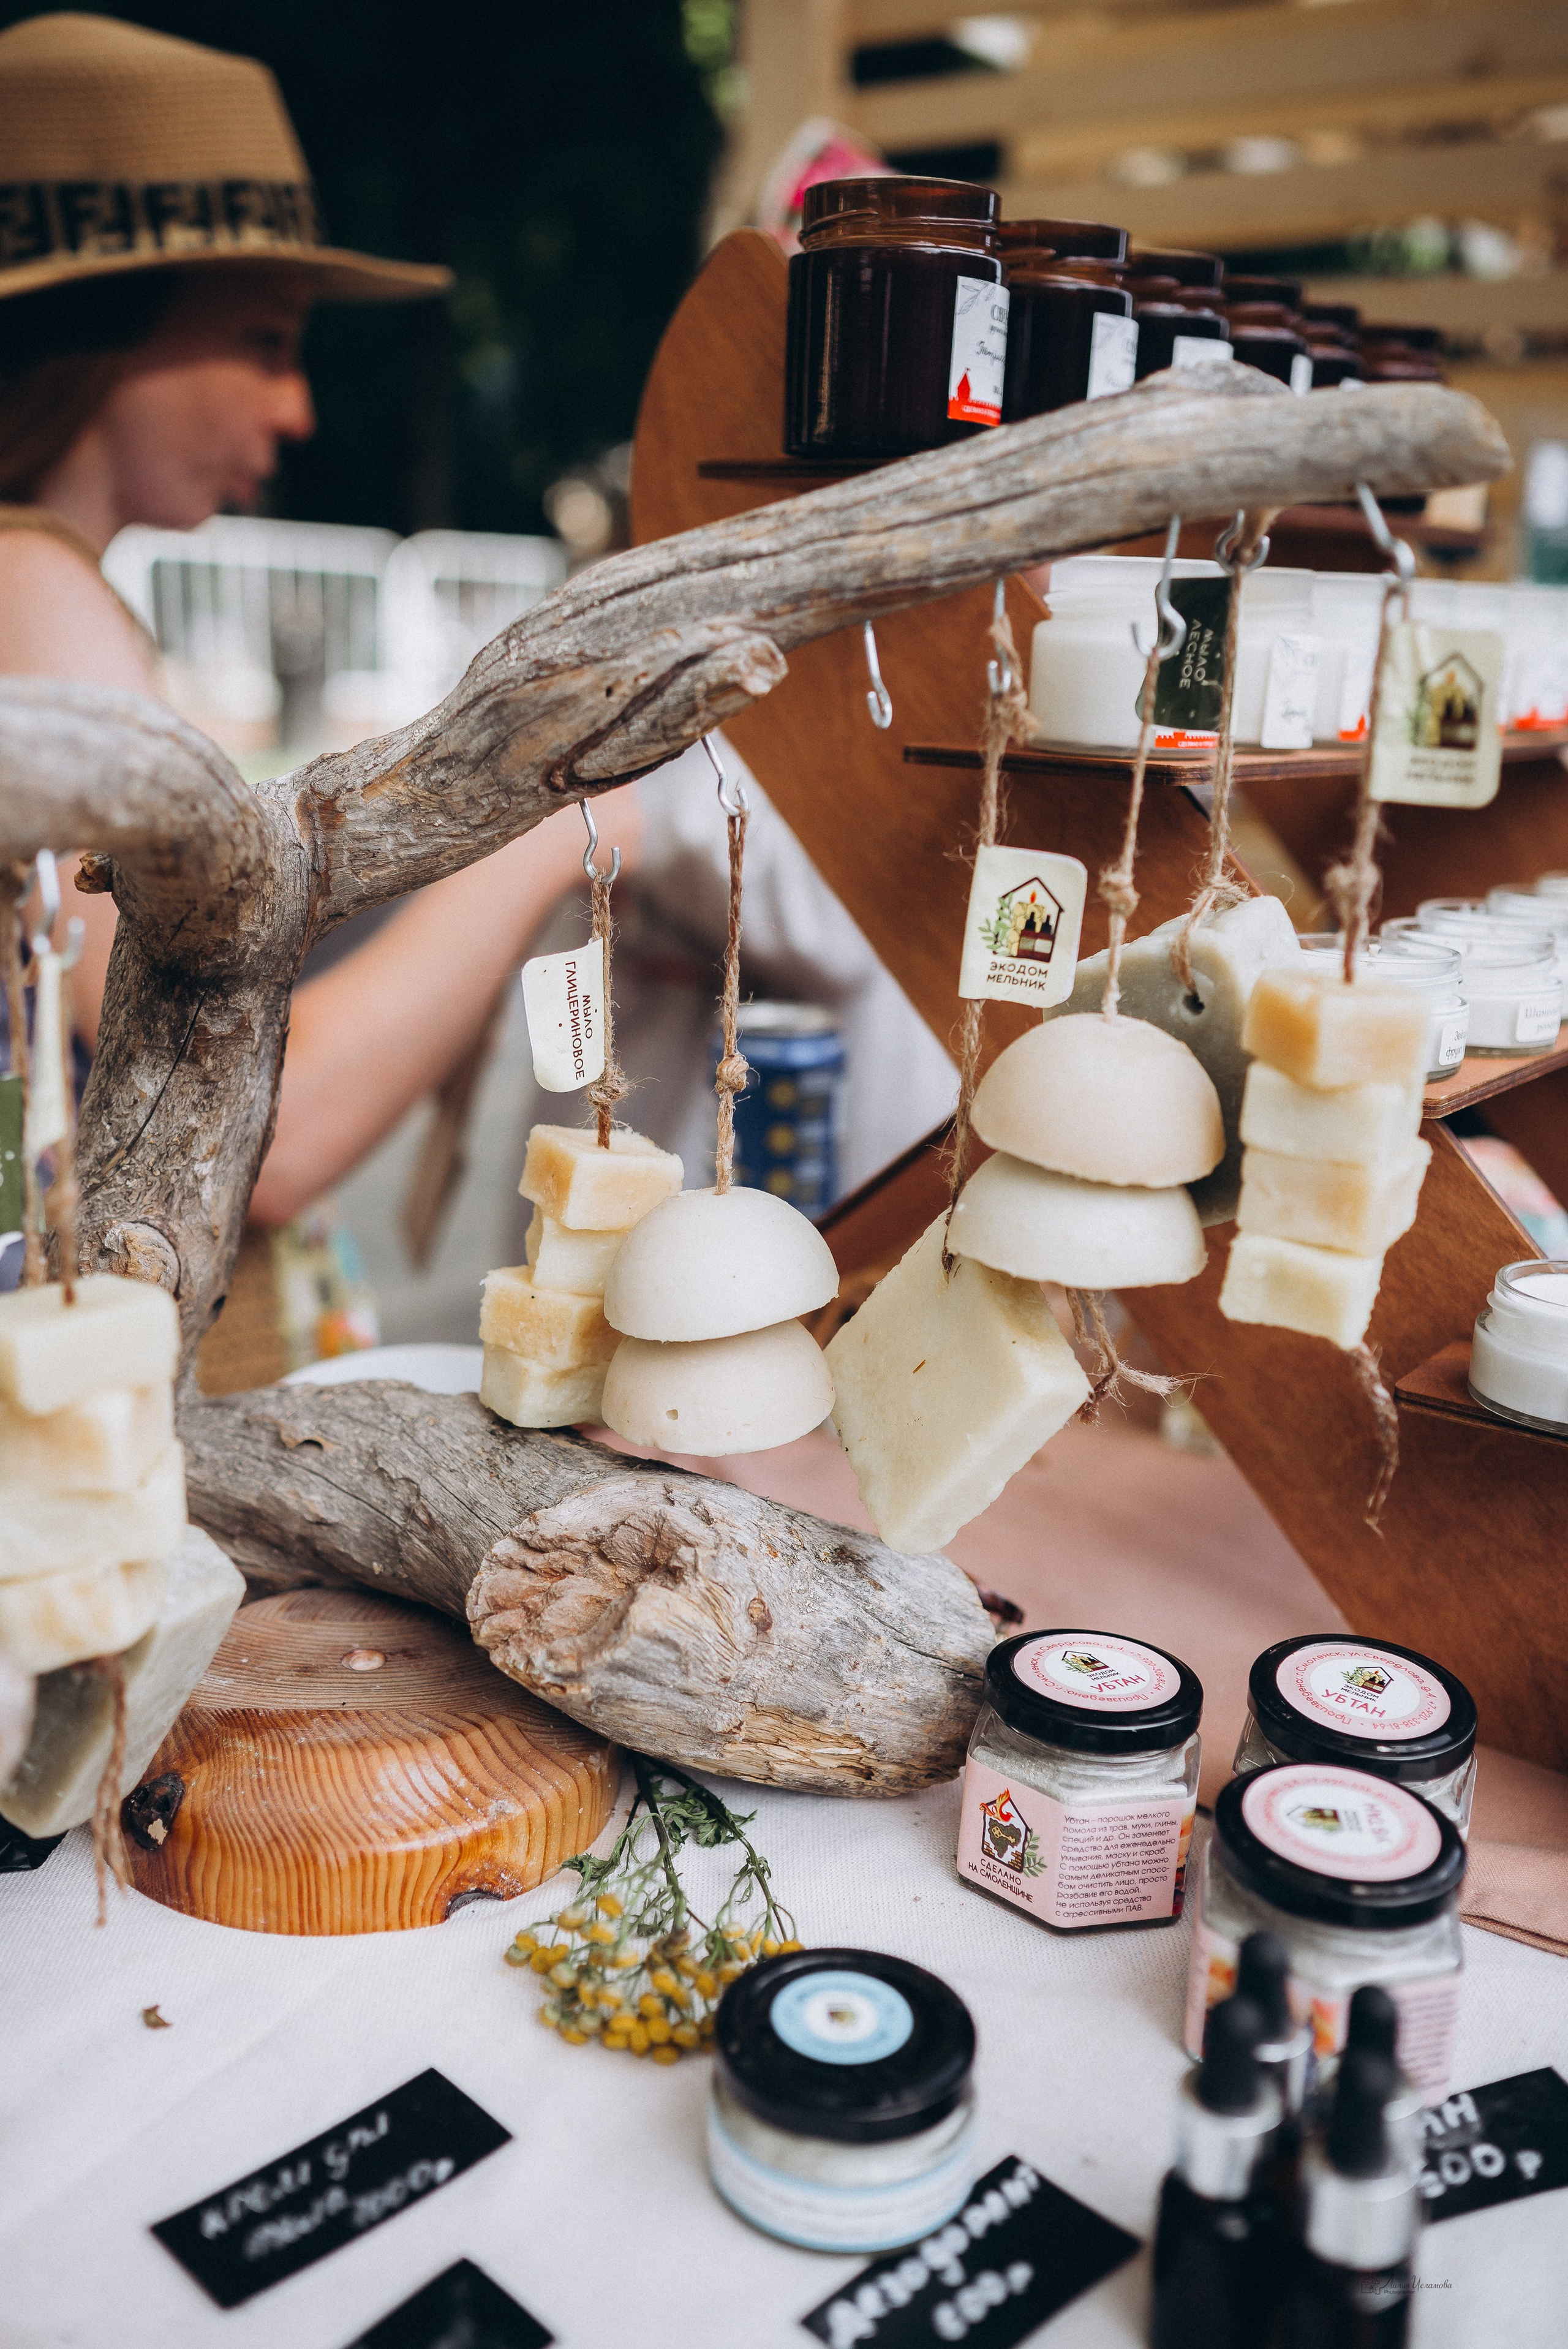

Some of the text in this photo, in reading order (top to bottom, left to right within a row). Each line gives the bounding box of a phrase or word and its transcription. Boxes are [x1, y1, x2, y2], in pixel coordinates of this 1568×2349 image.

[1178, 619, 1202, 690] ЛЕСНОЕ
[989, 962, 1048, 978] ЭКОДОМ
[986, 974, 1046, 991] МЕЛЬНИК
[565, 961, 585, 1080] ГЛИЦЕРИНОВОЕ
[582, 995, 593, 1039] МЫЛО
[1087, 1669, 1116, 1678] ЭКОДОМ
[1091, 1672, 1121, 1681] МЕЛЬНИК
[1090, 1675, 1147, 1693] УБТАН
[1344, 1684, 1379, 1699] ЭКОДОМ
[1063, 1689, 1149, 1702] Произведено:
[1295, 1678, 1352, 1725] Произведено:
[1340, 1687, 1377, 1703] МЕЛЬНИК
[1321, 1689, 1386, 1717] УБТАН
[1064, 1815, 1090, 1825] Убтан
[1137, 1811, 1170, 1820] мелкого
[1062, 1835, 1094, 1844] специй
[1132, 1830, 1170, 1838] заменяет
[1063, 1826, 1096, 1834] помола
[1061, 1845, 1102, 1853] средство
[1120, 1838, 1176, 1849] еженедельно
[1061, 1853, 1103, 1862] умывания,
[1139, 1847, 1167, 1857] скраб.
[980, 1858, 1022, 1885] СДЕЛАНО
[1069, 1862, 1109, 1872] помощью
[1111, 1860, 1140, 1868] убтана
[1142, 1857, 1169, 1865] можно
[968, 1861, 1033, 1903] НА СМОЛЕНЩИНЕ
[1090, 1869, 1139, 1880] деликатным
[1139, 1875, 1168, 1885] просто
[1057, 1891, 1098, 1899] разбавив
[1115, 1887, 1141, 1895] водой,
[1069, 1899, 1111, 1909] используя
[1113, 1895, 1152, 1906] средства
[1063, 1907, 1124, 1919] агрессивными
[1125, 1904, 1144, 1912] ПАВ.
